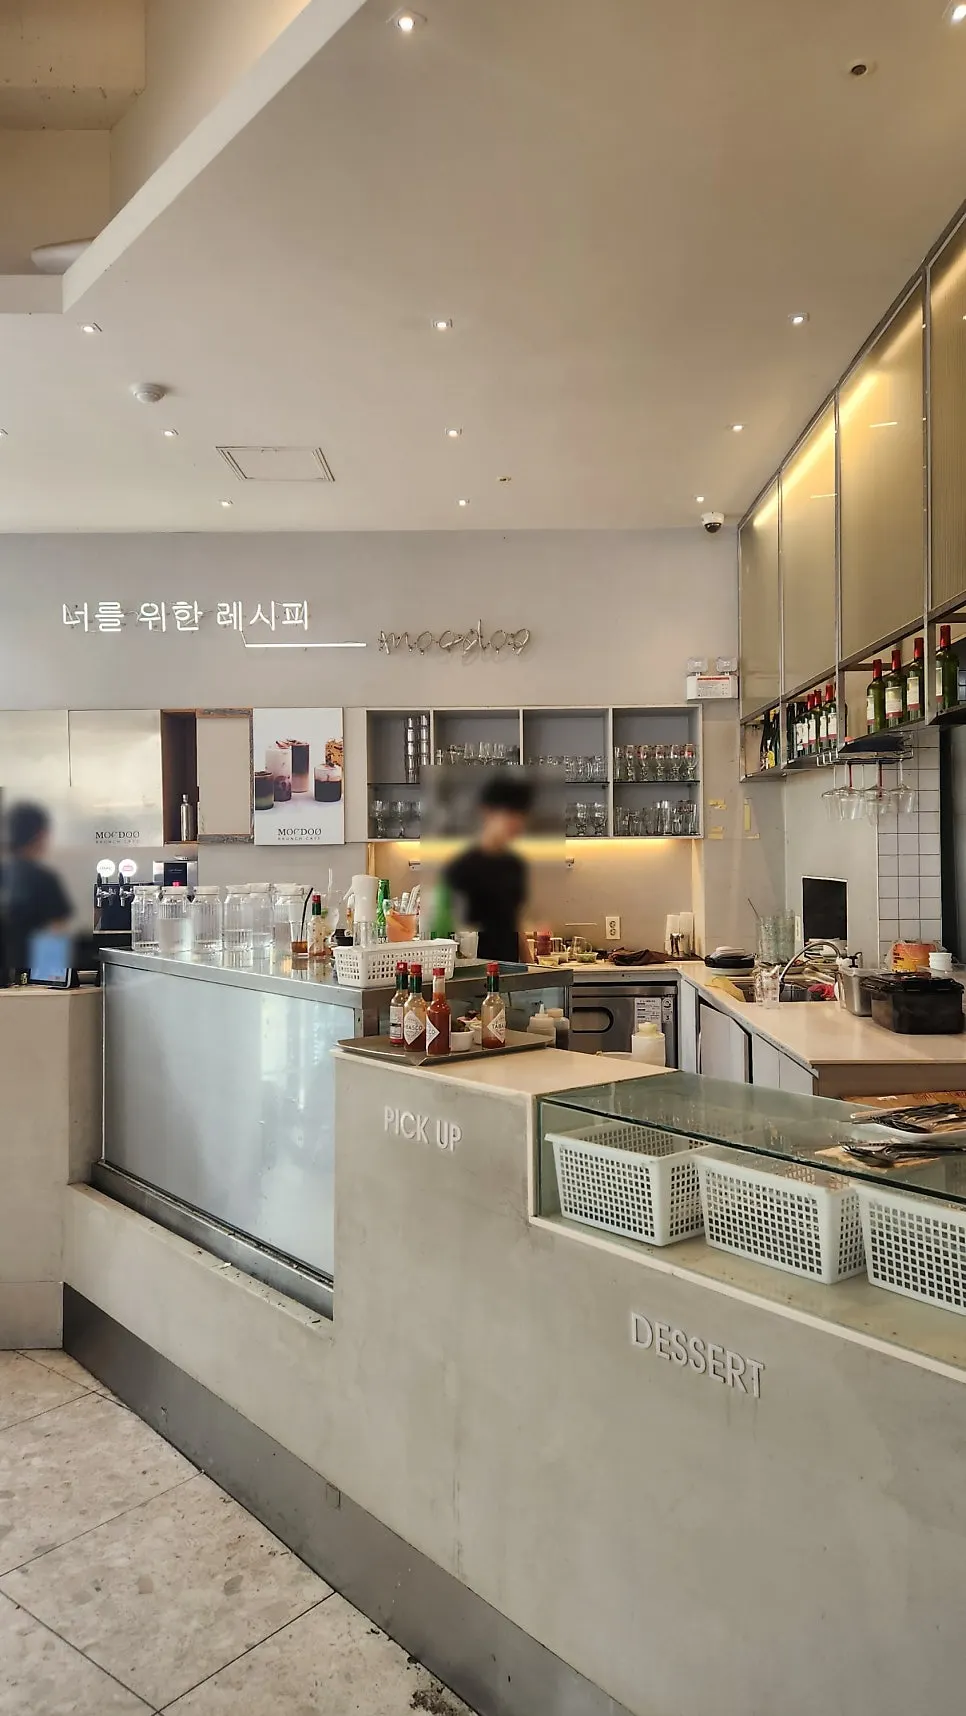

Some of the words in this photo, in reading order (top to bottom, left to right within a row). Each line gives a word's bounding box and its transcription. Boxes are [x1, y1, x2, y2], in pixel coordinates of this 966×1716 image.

[62, 601, 125, 632] 너를
[138, 600, 203, 632] 위한
[216, 600, 309, 632] 레시피
[383, 1106, 431, 1146] PICK
[435, 1119, 463, 1153] UP
[630, 1310, 766, 1398] DESSERT
